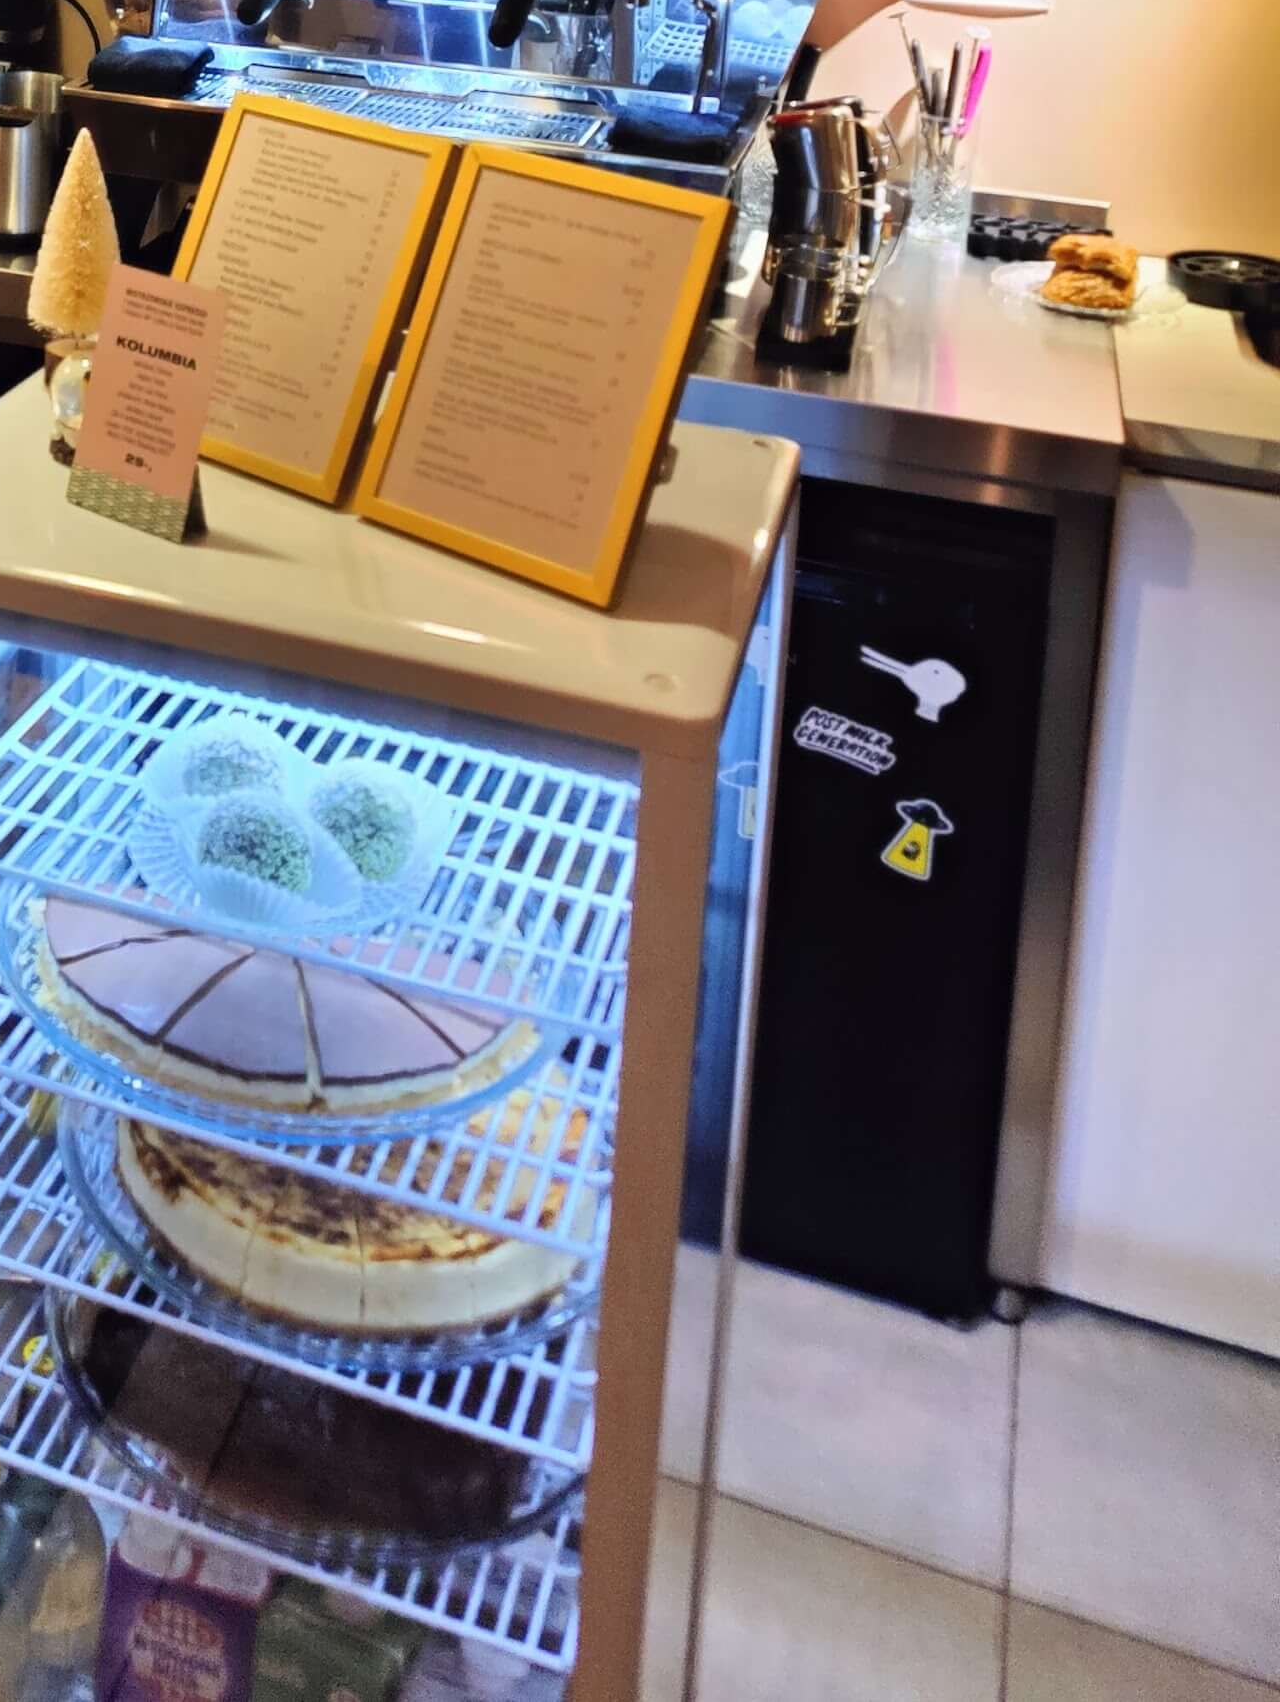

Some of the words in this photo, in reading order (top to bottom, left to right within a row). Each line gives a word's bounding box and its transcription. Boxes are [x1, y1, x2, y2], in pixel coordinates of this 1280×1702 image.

[116, 335, 197, 370] KOLUMBIA
[797, 725, 892, 768] GENERATION
[804, 709, 845, 731] POST
[843, 725, 888, 749] MILK
